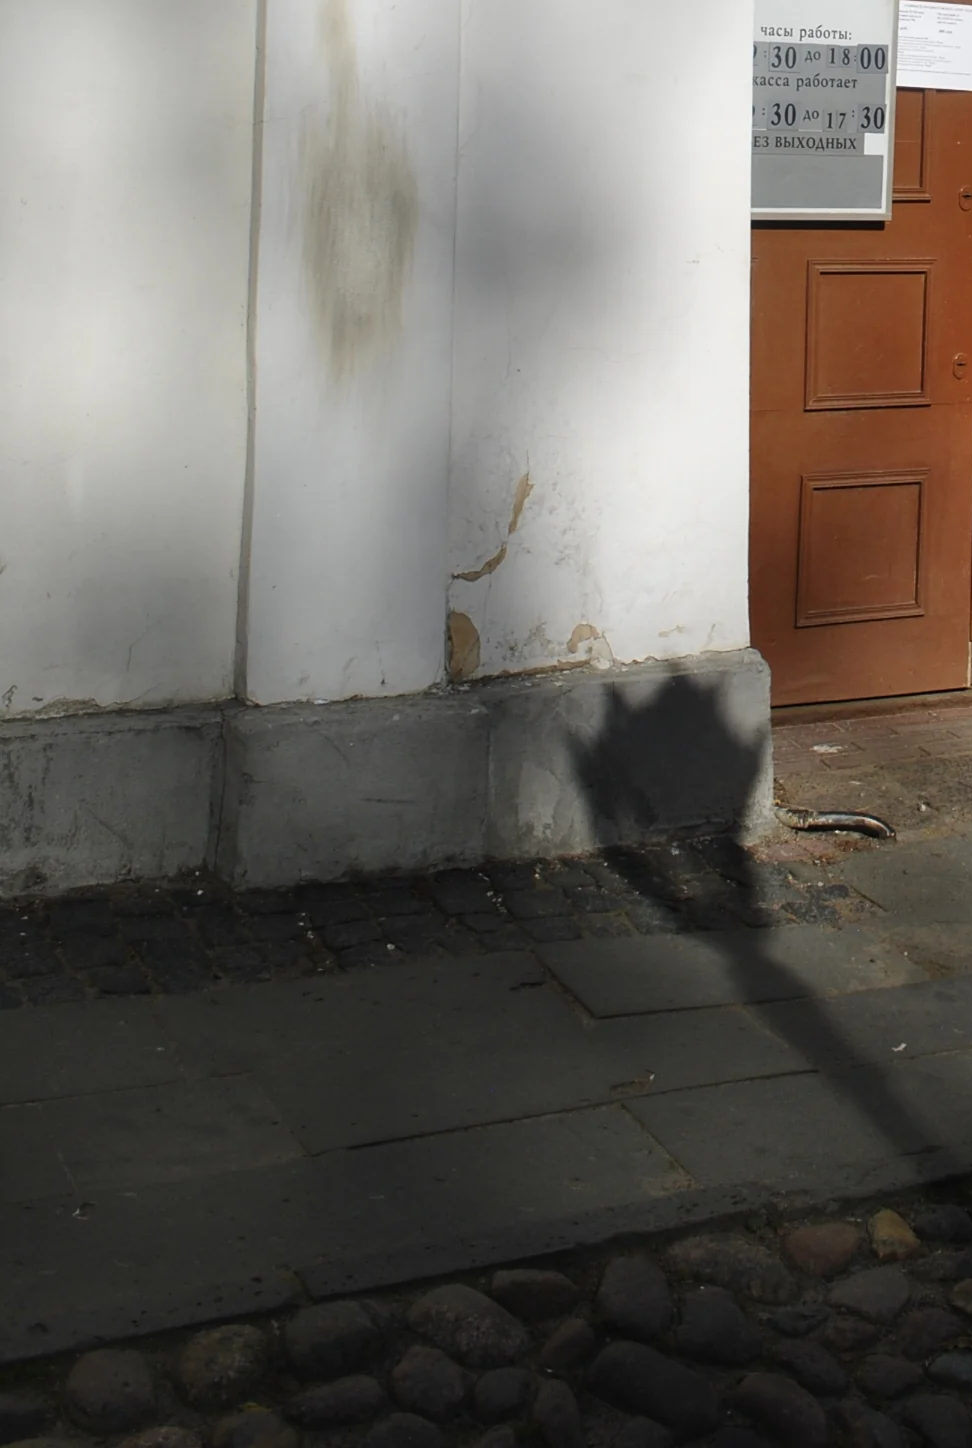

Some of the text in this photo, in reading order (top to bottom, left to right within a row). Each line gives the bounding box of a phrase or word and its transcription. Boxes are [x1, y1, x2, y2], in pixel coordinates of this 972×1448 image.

[760, 24, 852, 41] часы работы:
[804, 50, 821, 63] до
[796, 72, 858, 91] работает
[803, 109, 820, 121] до
[775, 136, 857, 151] ВЫХОДНЫХ
